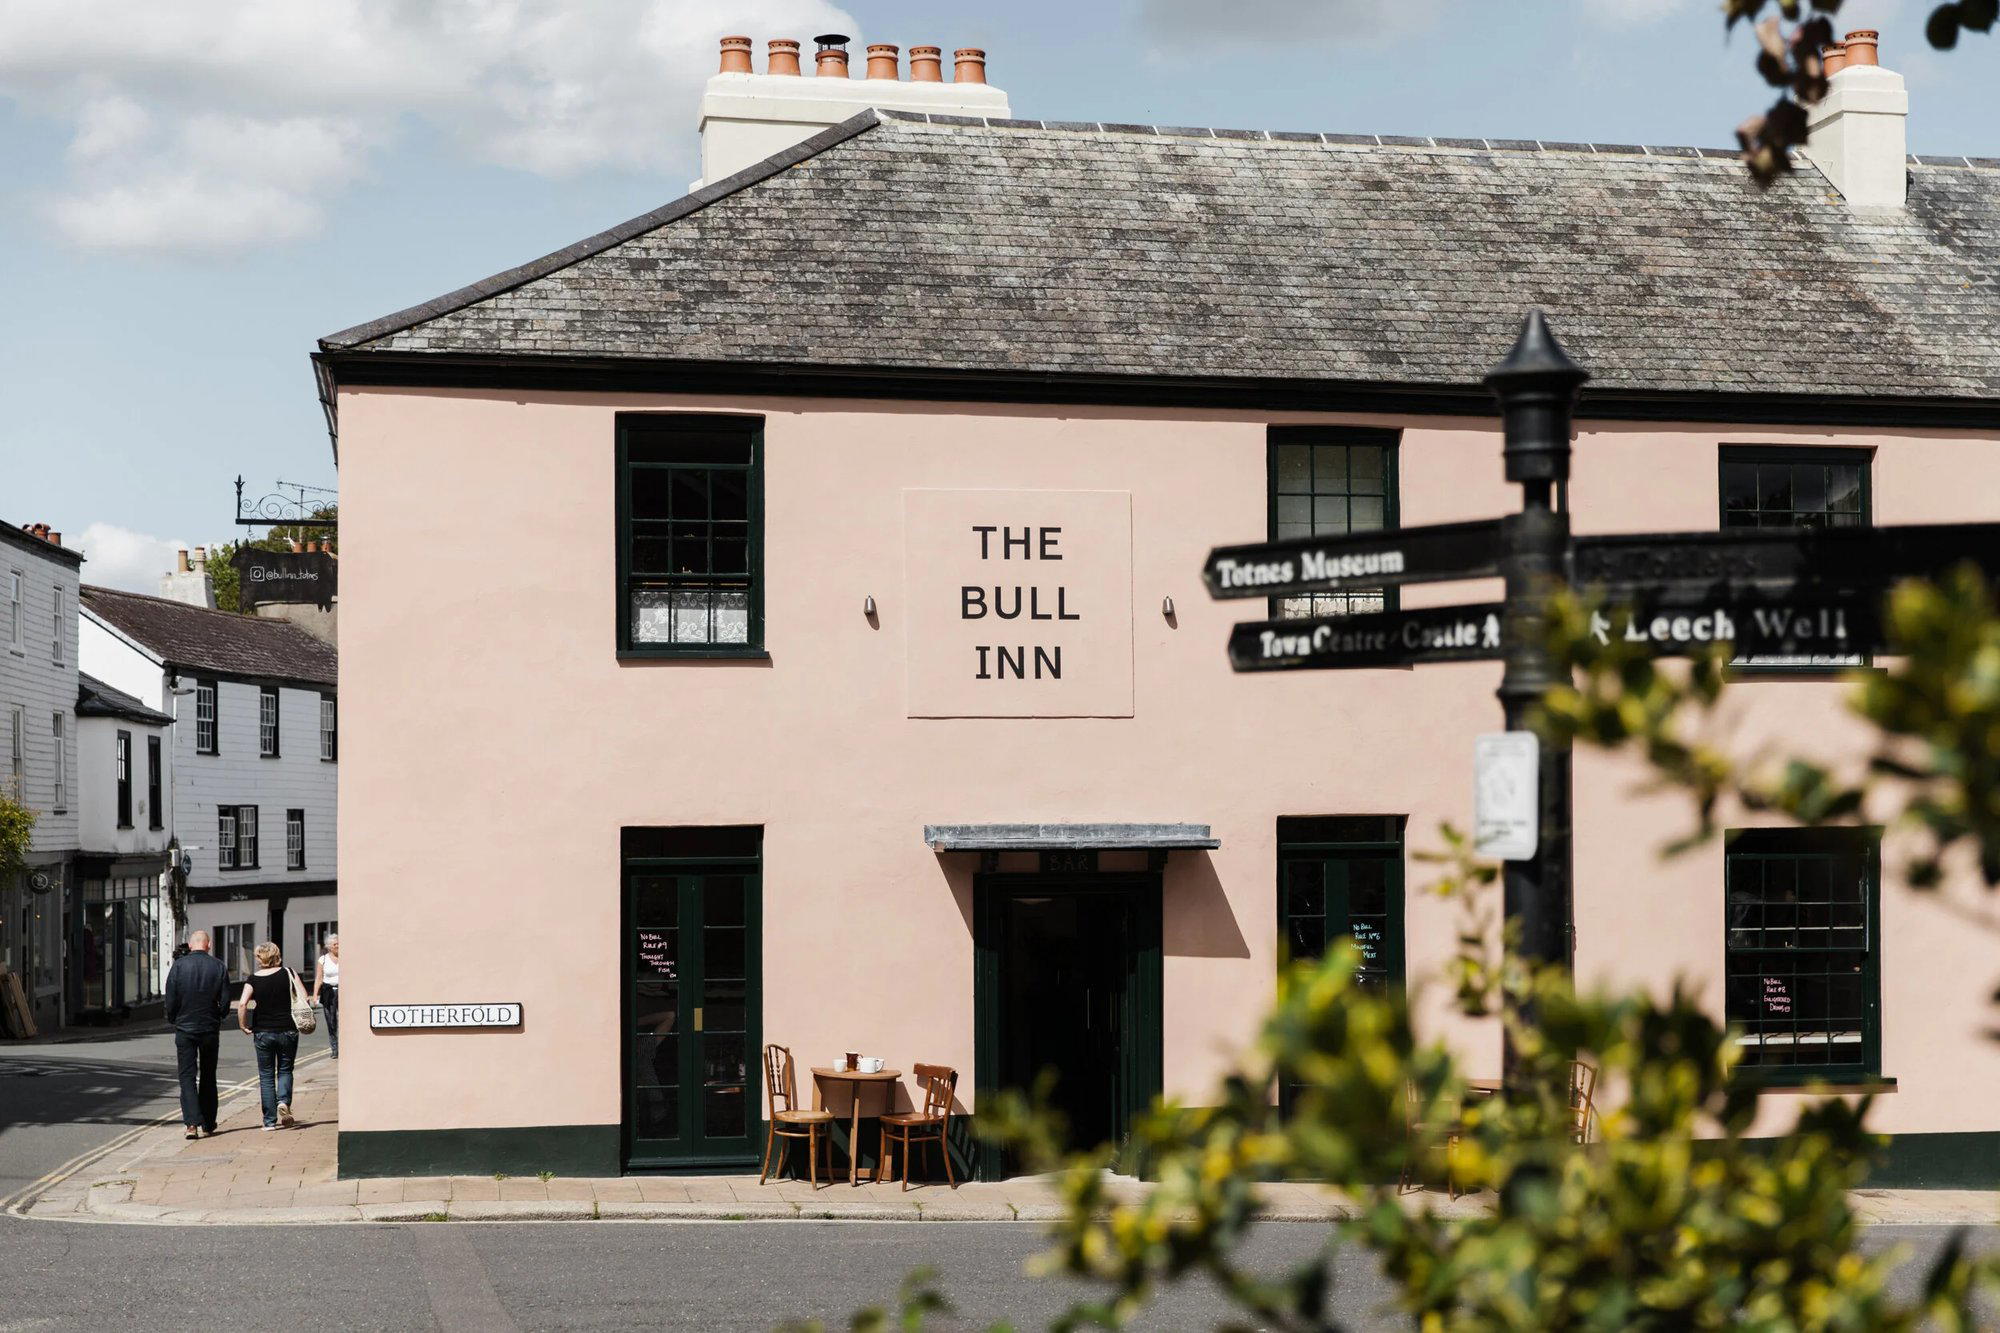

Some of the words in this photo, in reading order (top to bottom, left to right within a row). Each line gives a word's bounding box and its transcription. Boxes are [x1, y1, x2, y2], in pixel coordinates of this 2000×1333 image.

[972, 526, 1063, 560] THE
[1216, 559, 1294, 588] Totnes
[1300, 550, 1404, 580] Museum
[961, 586, 1080, 620] BULL
[1624, 608, 1736, 641] Leech
[1754, 608, 1848, 639] Well
[1259, 630, 1311, 658] Town
[975, 646, 1062, 680] INN
[377, 1007, 512, 1024] ROTHERFOLD
